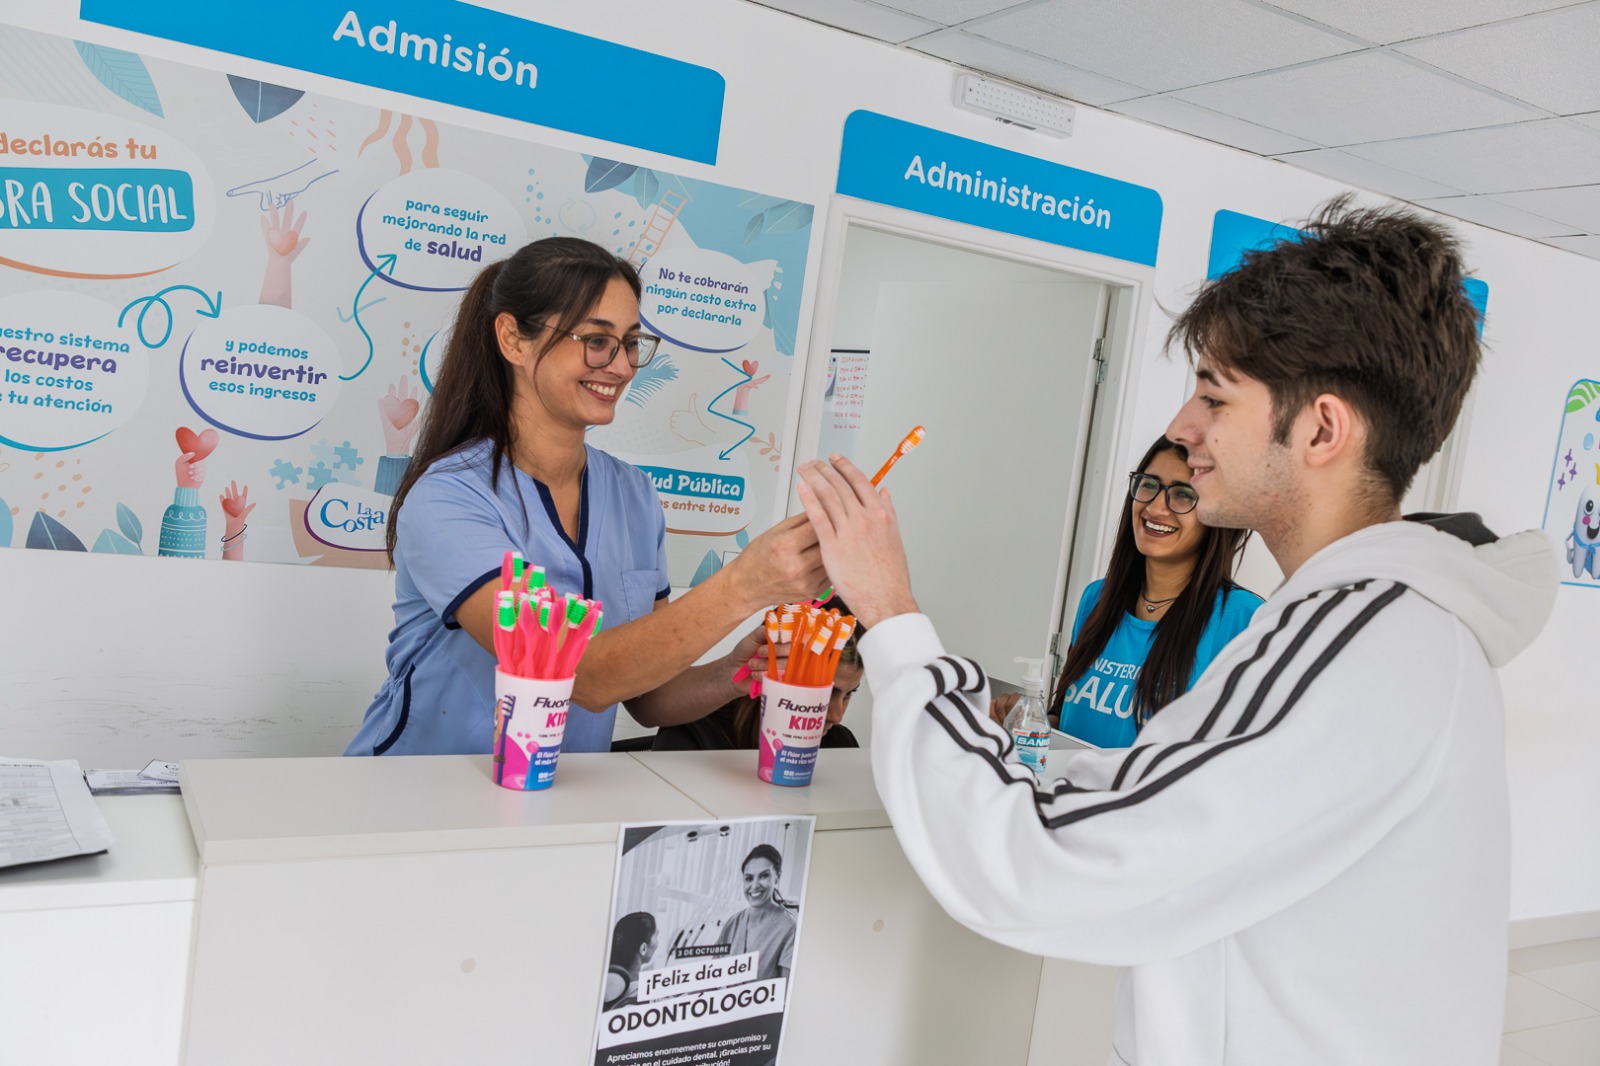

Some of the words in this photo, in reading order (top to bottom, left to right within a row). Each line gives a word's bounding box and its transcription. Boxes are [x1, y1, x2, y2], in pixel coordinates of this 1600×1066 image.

[332, 10, 538, 90] Admisión
[125, 137, 157, 160] tu
[0, 179, 54, 228] RA
[68, 181, 188, 224] SOCIAL
[904, 154, 1111, 230] Administración
[405, 200, 440, 214] para
[443, 207, 488, 223] seguir
[382, 214, 462, 237] mejorando
[465, 227, 479, 240] la
[482, 233, 506, 245] red
[404, 238, 422, 251] de
[427, 240, 482, 263] salud
[658, 267, 675, 280] No
[678, 271, 691, 283] te
[694, 276, 749, 294] cobrarán
[645, 283, 687, 300] ningún
[690, 294, 721, 306] costo
[724, 298, 757, 312] extra
[656, 304, 679, 315] por
[681, 306, 742, 326] declararla
[0, 327, 54, 343] estro
[59, 332, 130, 353] sistema
[225, 340, 234, 352] y
[238, 342, 308, 360] podemos
[5, 369, 31, 384] los
[35, 376, 94, 391] costos
[200, 356, 327, 385] reinvertir
[7, 390, 29, 405] tu
[33, 394, 113, 414] atención
[208, 381, 245, 394] esos
[249, 382, 317, 402] ingresos
[677, 474, 741, 497] Pública
[320, 498, 385, 533] Costa
[357, 502, 372, 515] La
[672, 500, 706, 512] entre
[788, 714, 824, 731] KIDS
[684, 949, 695, 957] DE
[695, 945, 729, 956] OCTUBRE
[646, 969, 691, 995] ¡Feliz
[695, 964, 722, 981] día
[727, 956, 753, 976] del
[607, 983, 777, 1034] ODONTÓLOGO!
[606, 1050, 654, 1064] Apreciamos
[654, 1042, 707, 1057] enormemente
[707, 1041, 717, 1049] su
[717, 1034, 762, 1048] compromiso
[762, 1033, 768, 1042] y
[661, 1054, 692, 1066] cuidado
[692, 1050, 718, 1061] dental.
[719, 1045, 748, 1059] ¡Gracias
[748, 1044, 762, 1054] por
